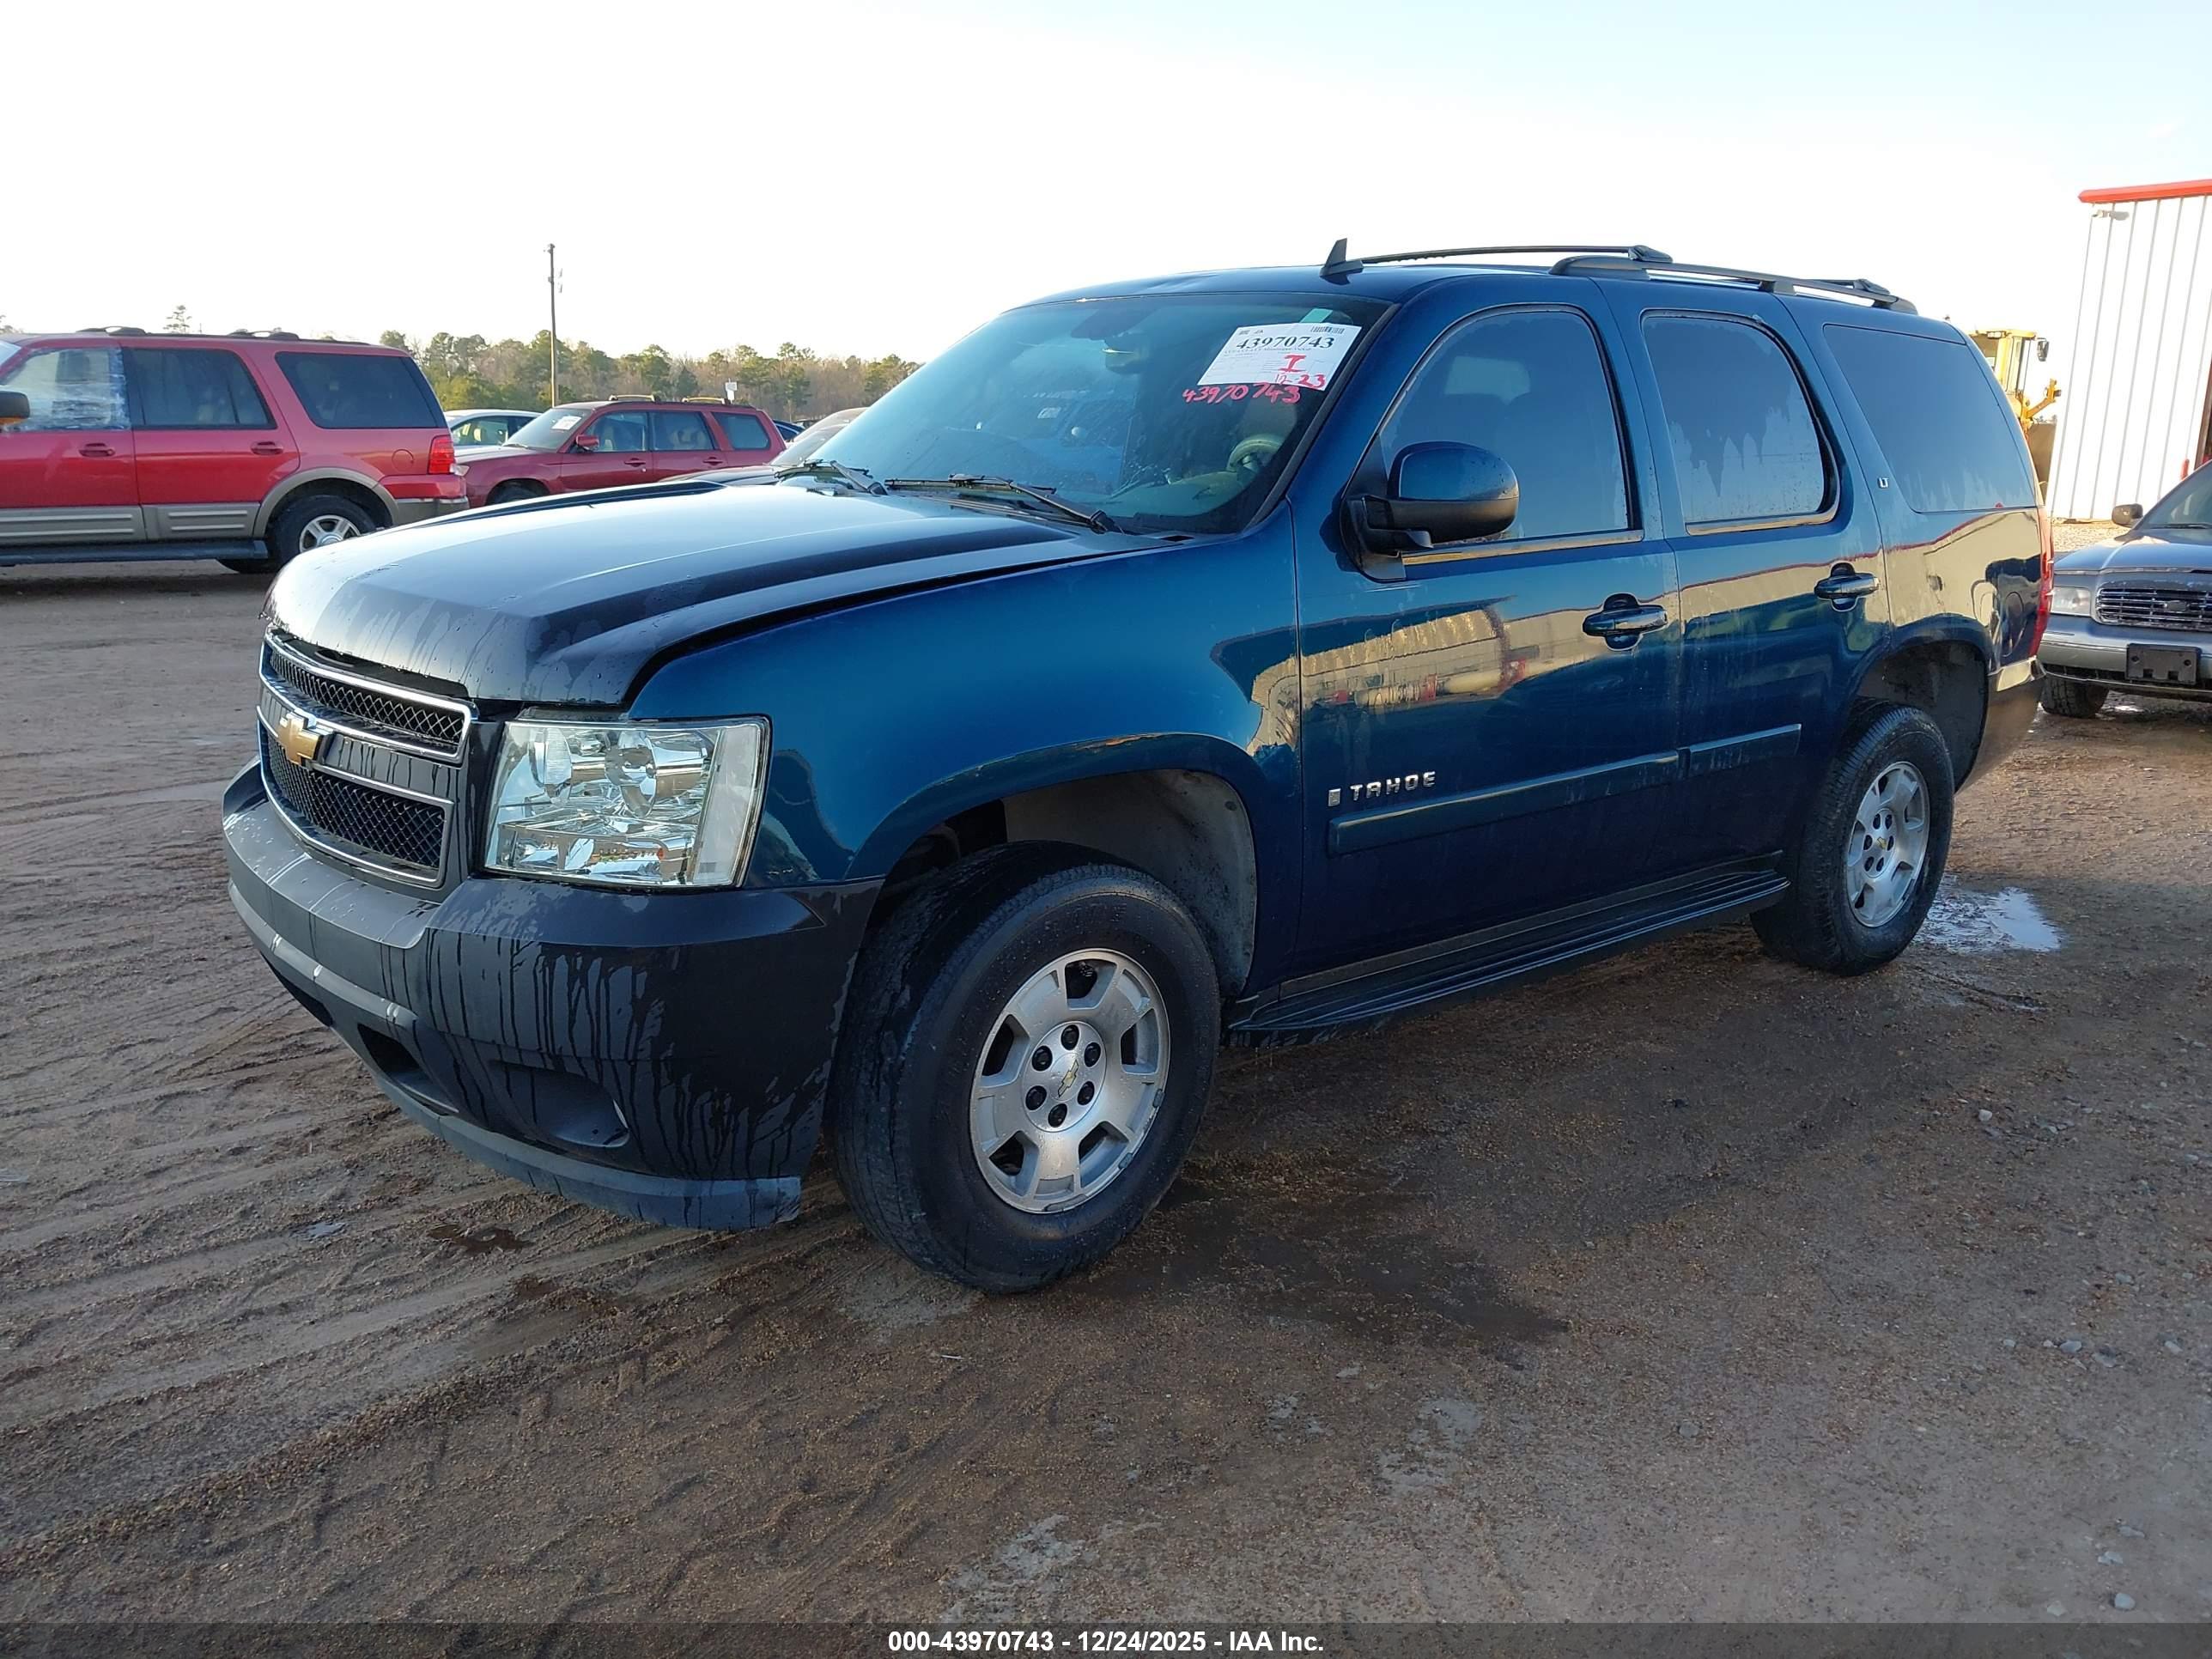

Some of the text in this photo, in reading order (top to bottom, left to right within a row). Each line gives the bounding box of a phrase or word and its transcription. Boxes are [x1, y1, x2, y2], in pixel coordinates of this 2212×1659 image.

[1237, 336, 1334, 349] 43970743
[1878, 477, 1889, 489] LT
[1350, 771, 1436, 800] TAHOE
